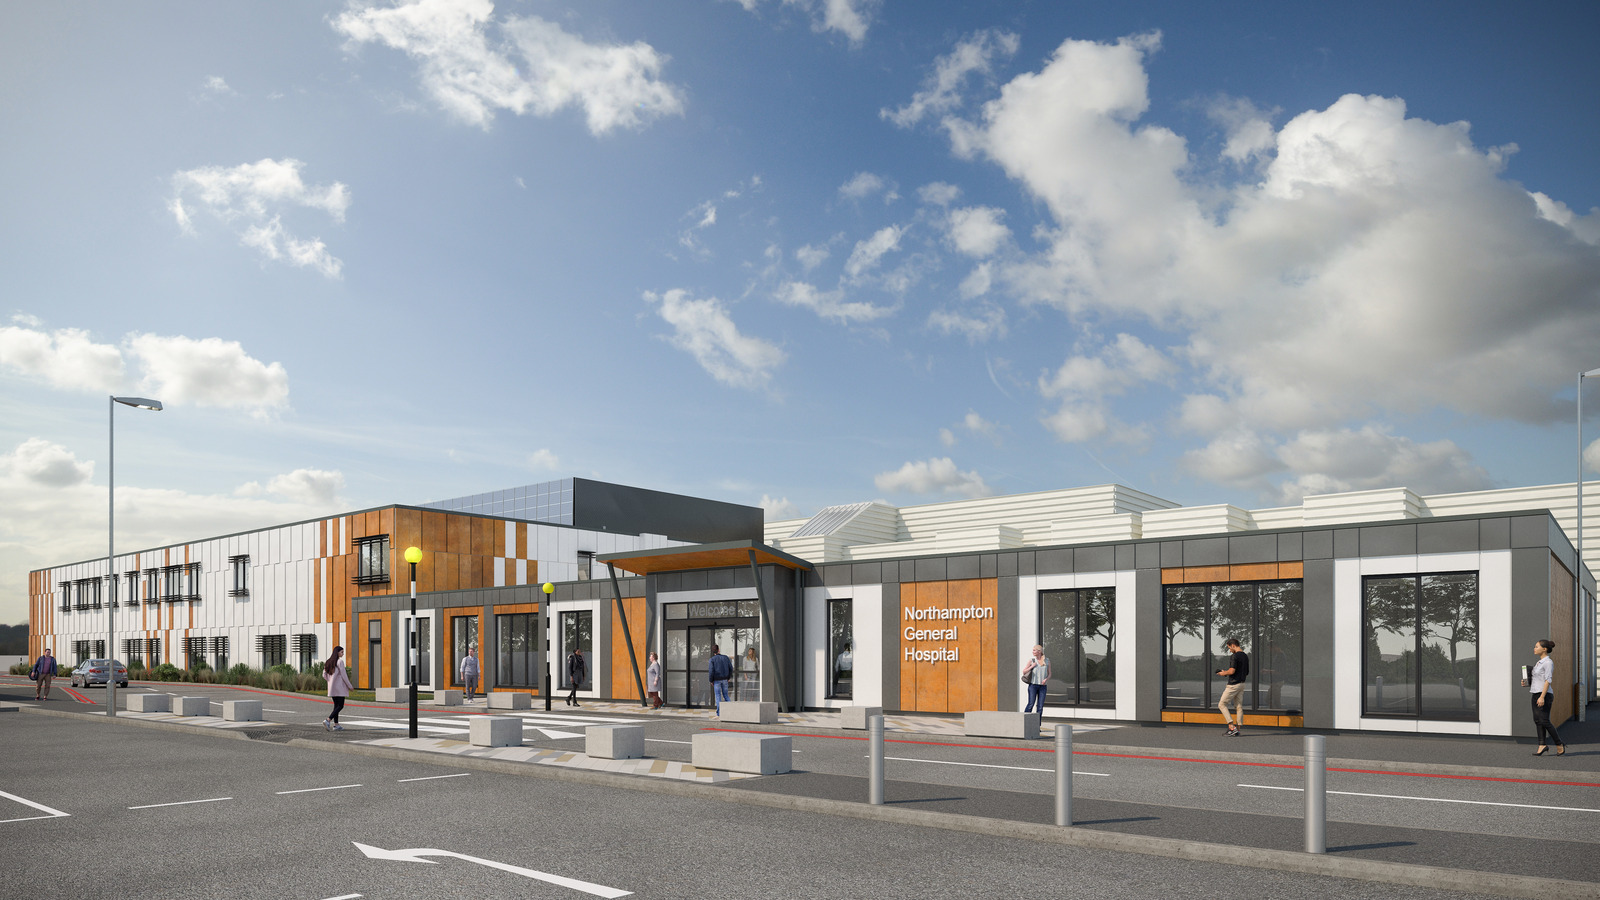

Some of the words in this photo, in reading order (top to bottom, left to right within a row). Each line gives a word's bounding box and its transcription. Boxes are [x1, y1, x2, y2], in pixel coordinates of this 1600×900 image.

[689, 604, 736, 617] Welcome
[904, 605, 994, 622] Northampton
[904, 626, 958, 641] General
[904, 647, 959, 665] Hospital
